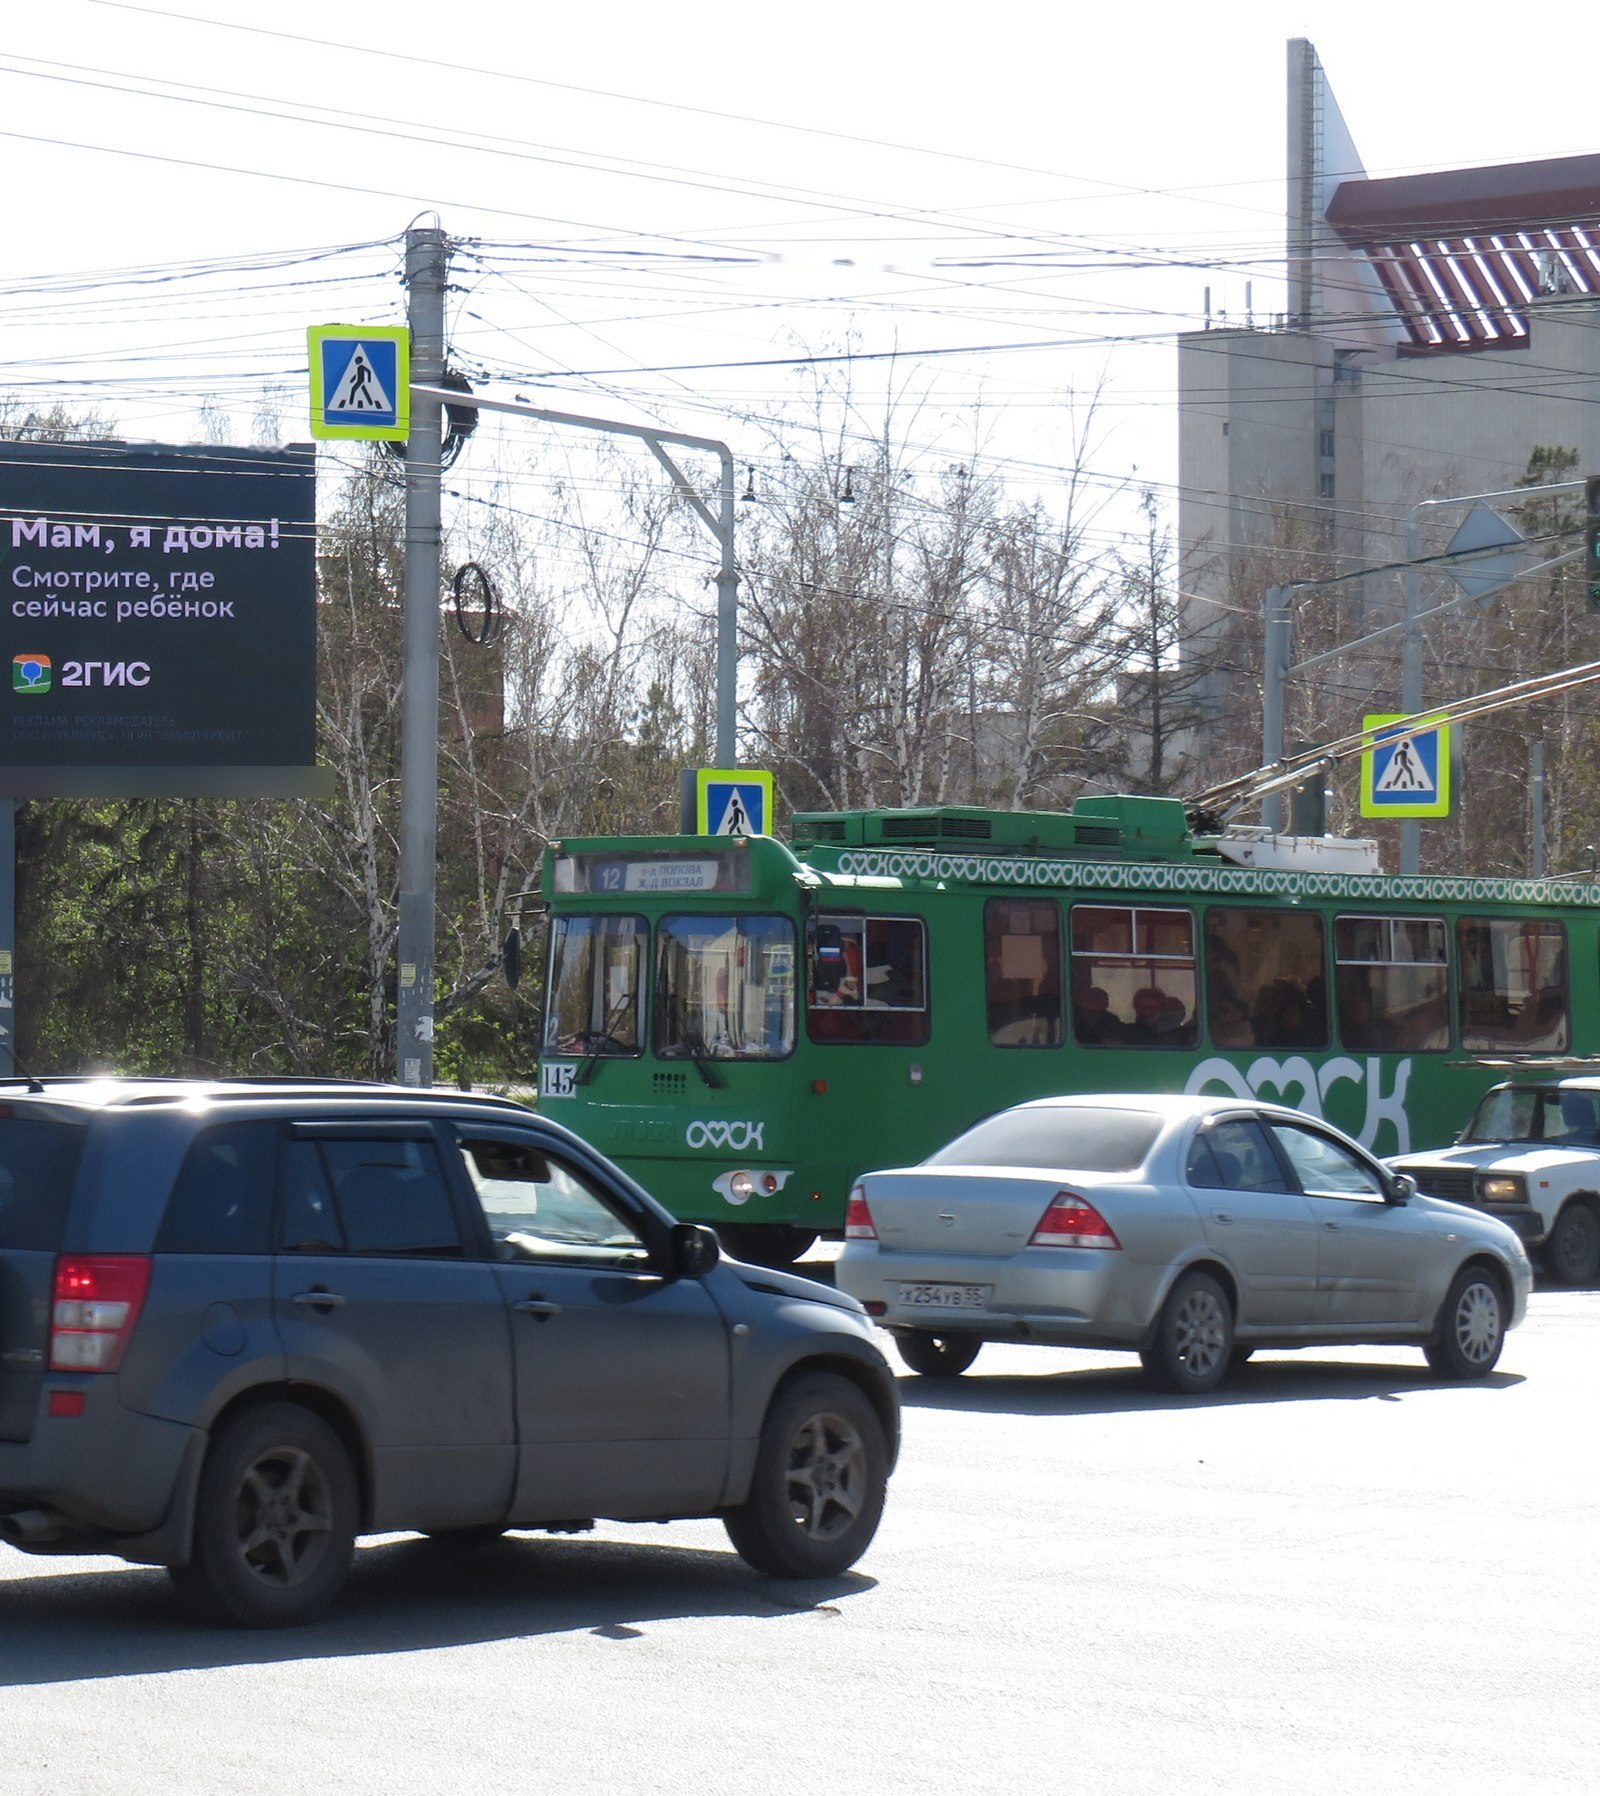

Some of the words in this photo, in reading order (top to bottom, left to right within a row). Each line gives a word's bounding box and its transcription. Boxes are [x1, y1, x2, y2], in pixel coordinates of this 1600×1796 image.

[11, 516, 116, 554] Мам,
[129, 526, 150, 548] я
[163, 517, 280, 553] дома!
[12, 565, 160, 593] Смотрите,
[169, 570, 215, 591] где
[12, 594, 107, 618] сейчас
[116, 593, 235, 622] ребёнок
[62, 661, 151, 687] 2ГИС
[602, 868, 621, 889] 12
[659, 866, 703, 875] ПОПОВА
[660, 877, 704, 888] ВОКЗАЛ
[545, 1067, 573, 1094] 145
